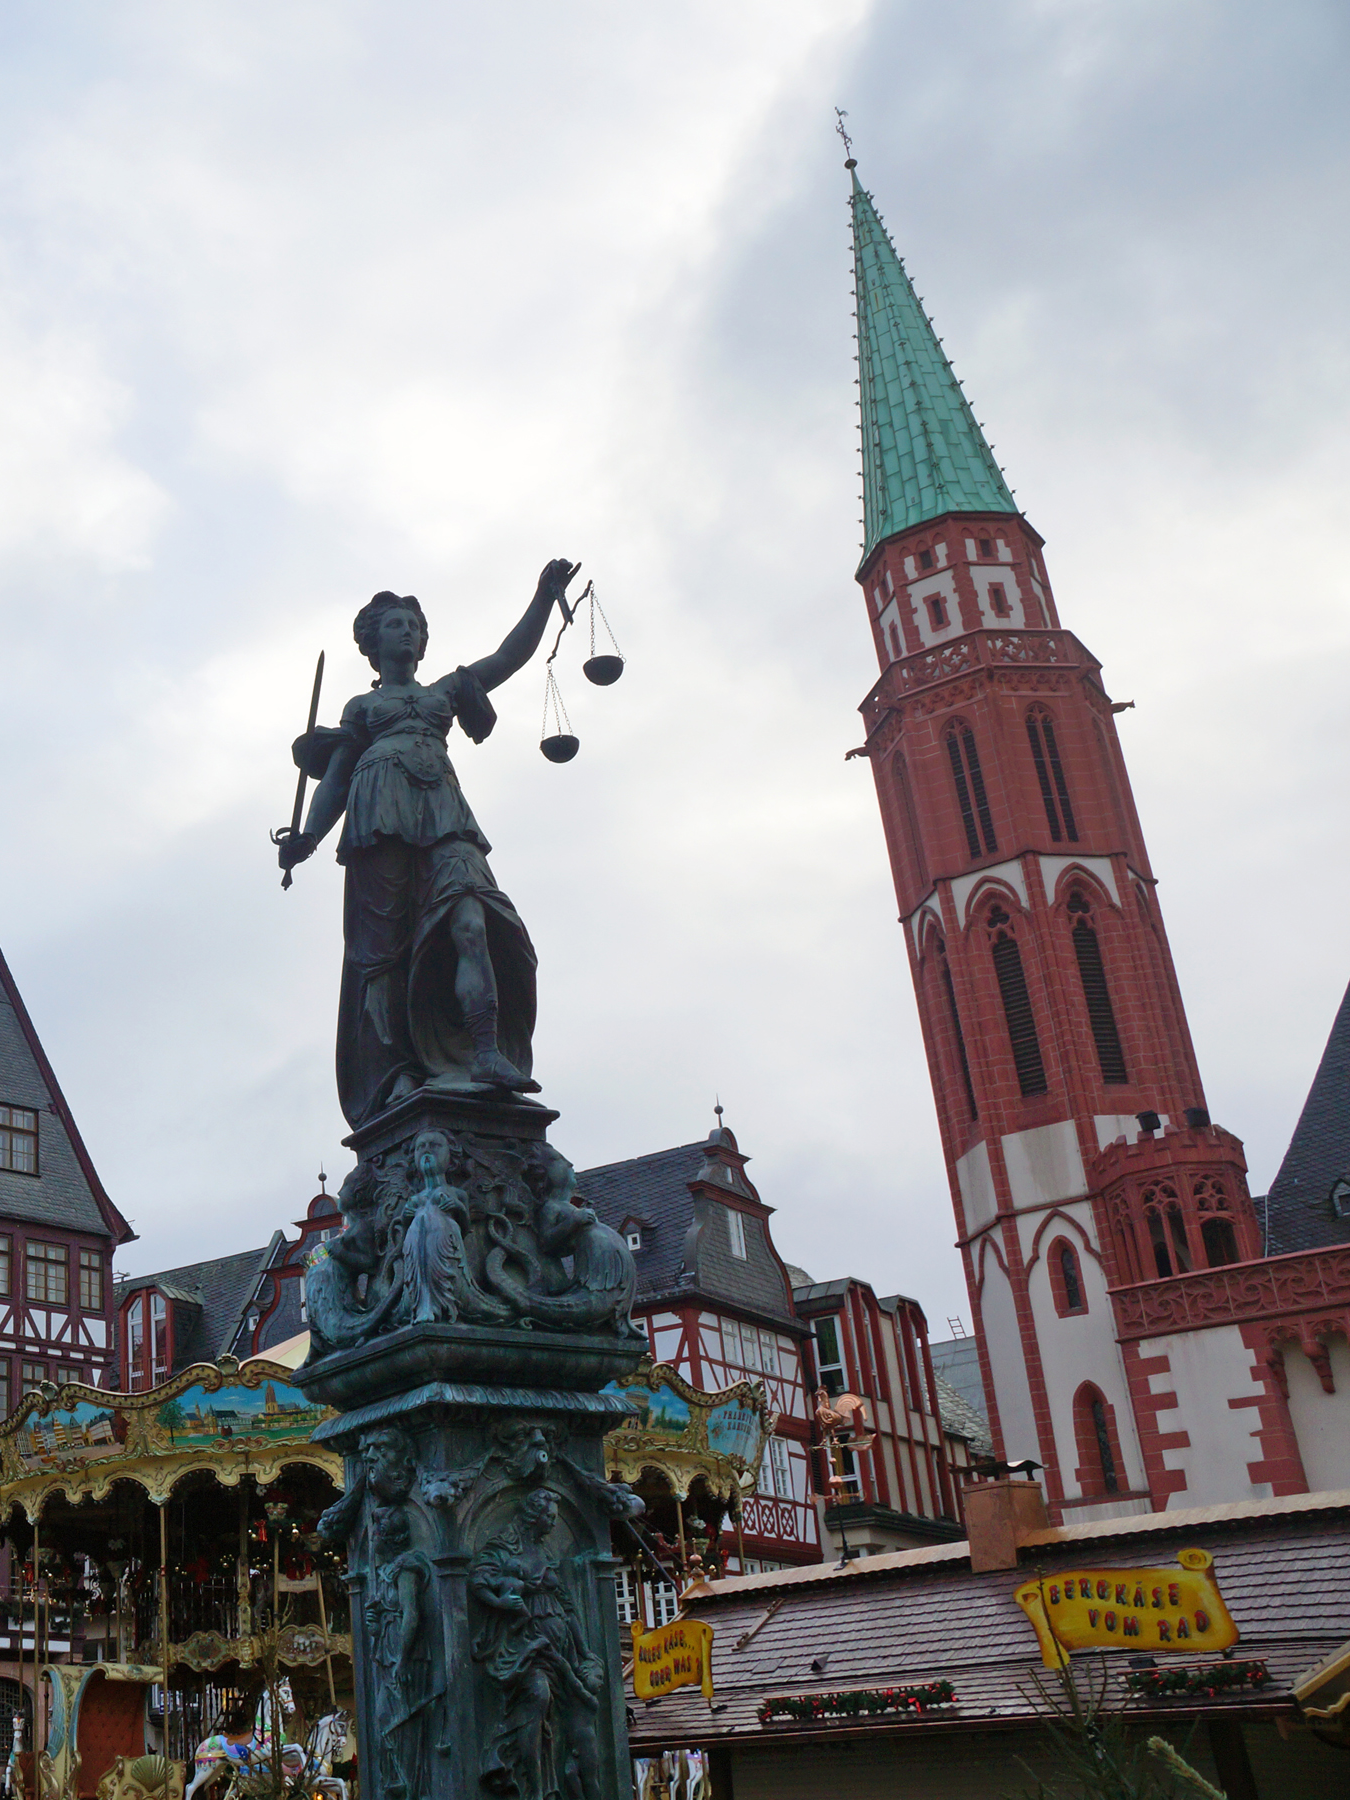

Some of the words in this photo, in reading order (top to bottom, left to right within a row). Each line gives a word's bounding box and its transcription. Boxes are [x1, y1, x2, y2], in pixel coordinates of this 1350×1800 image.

[1049, 1578, 1180, 1608] BERGKÄSE
[1088, 1608, 1139, 1636] VOM
[1157, 1609, 1209, 1642] RAD
[639, 1643, 661, 1664] ALLES
[673, 1655, 691, 1675] WAS
